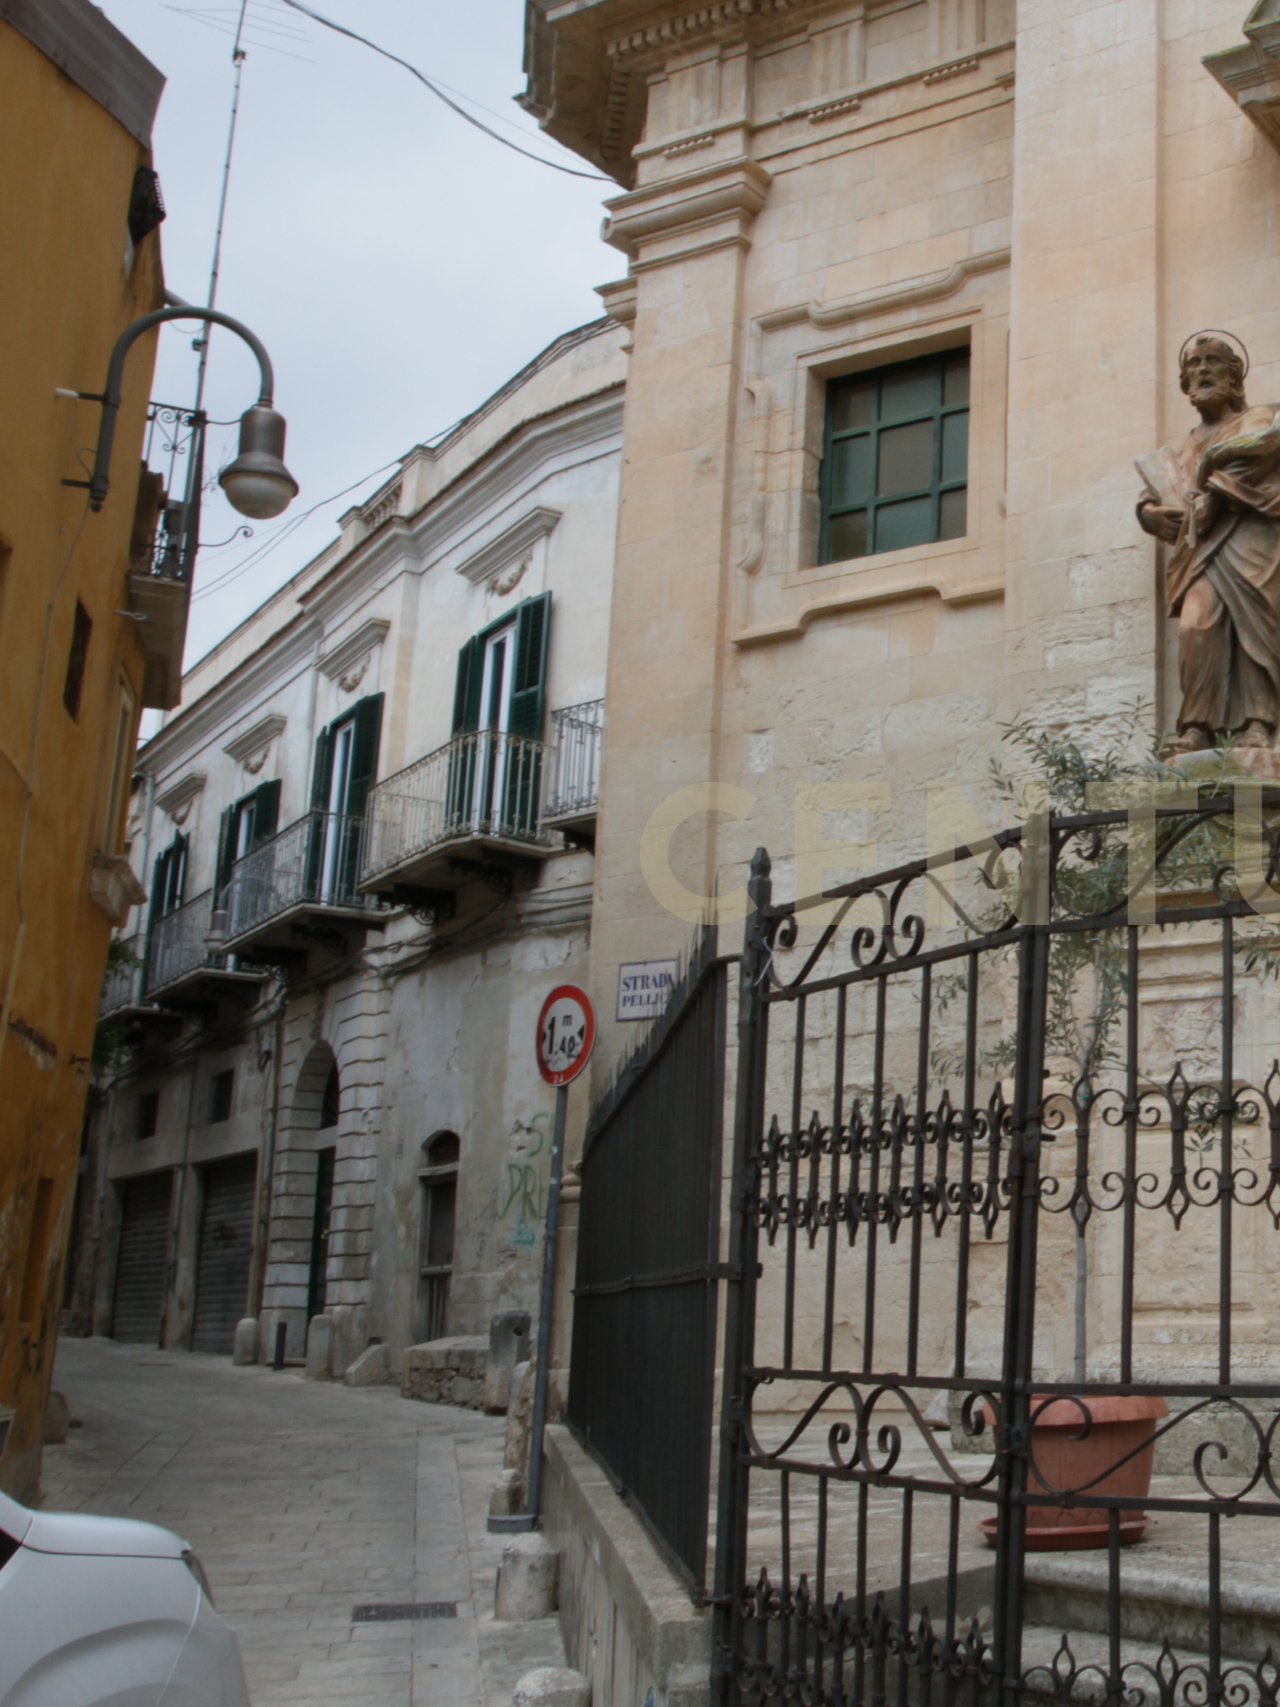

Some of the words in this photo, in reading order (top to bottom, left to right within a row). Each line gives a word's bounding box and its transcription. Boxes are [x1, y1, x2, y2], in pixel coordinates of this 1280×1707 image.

[622, 973, 675, 992] STRADA
[622, 992, 668, 1008] PELLIC
[562, 1014, 573, 1027] m
